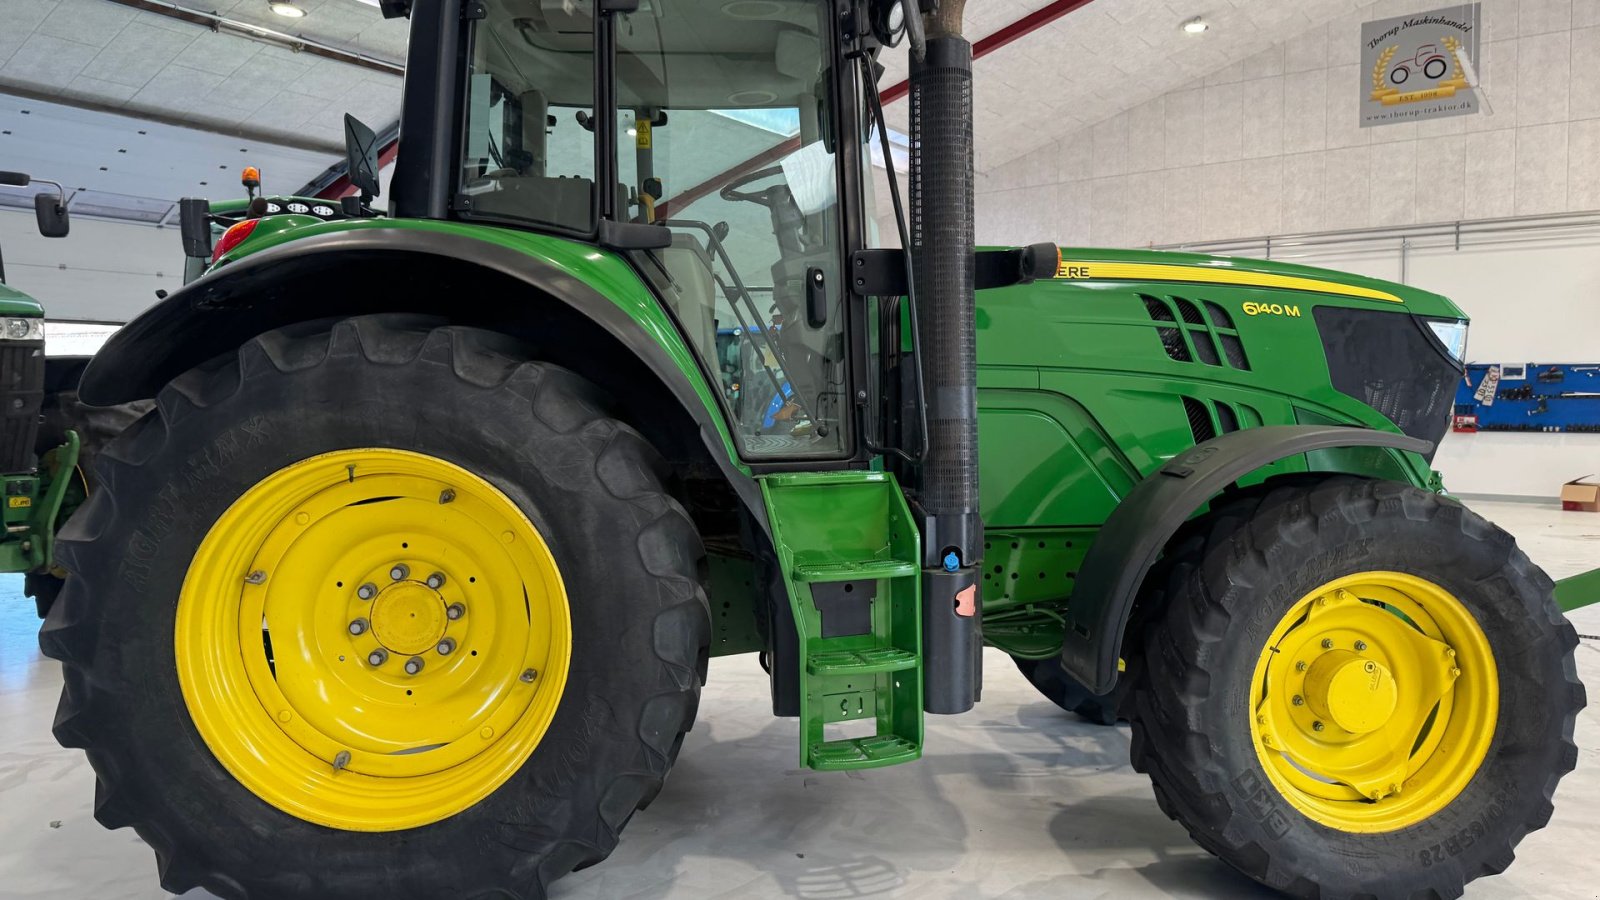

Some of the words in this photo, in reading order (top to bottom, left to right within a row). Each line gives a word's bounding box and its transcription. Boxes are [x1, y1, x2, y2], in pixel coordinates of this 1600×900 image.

[1367, 24, 1400, 50] Thorup
[1401, 15, 1473, 33] Maskinhandel
[1058, 266, 1090, 277] ERE
[1242, 301, 1283, 316] 6140
[1283, 304, 1301, 317] M
[1237, 774, 1289, 838] BKT
